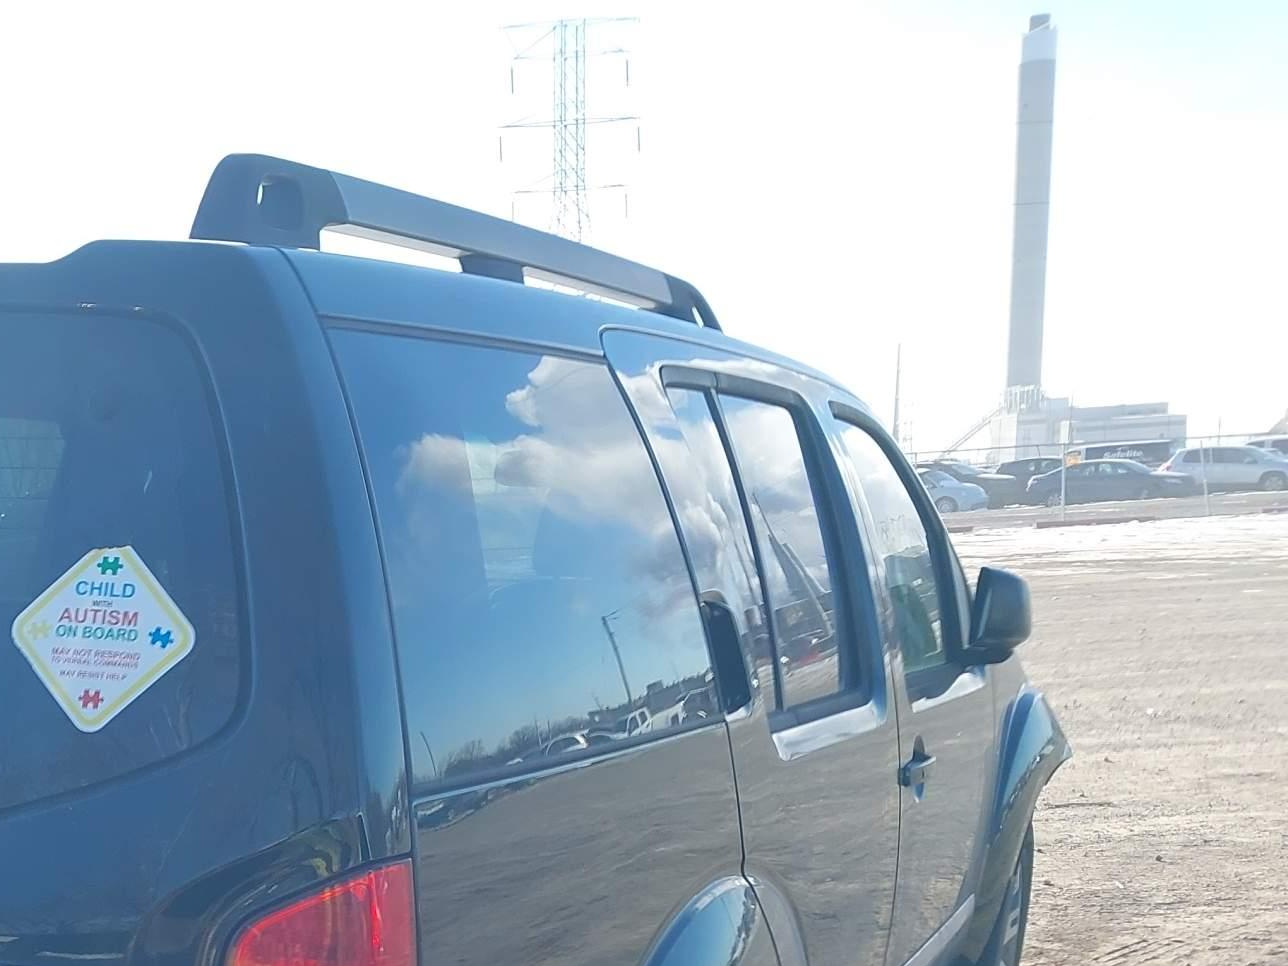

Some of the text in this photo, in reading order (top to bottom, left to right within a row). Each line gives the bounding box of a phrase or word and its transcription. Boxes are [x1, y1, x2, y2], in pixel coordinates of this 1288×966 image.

[75, 580, 136, 598] CHILD
[92, 600, 113, 608] WITH
[58, 607, 139, 627] AUTISM
[55, 624, 138, 641] ON BOARD
[51, 647, 141, 661] MAY NOT RESPOND
